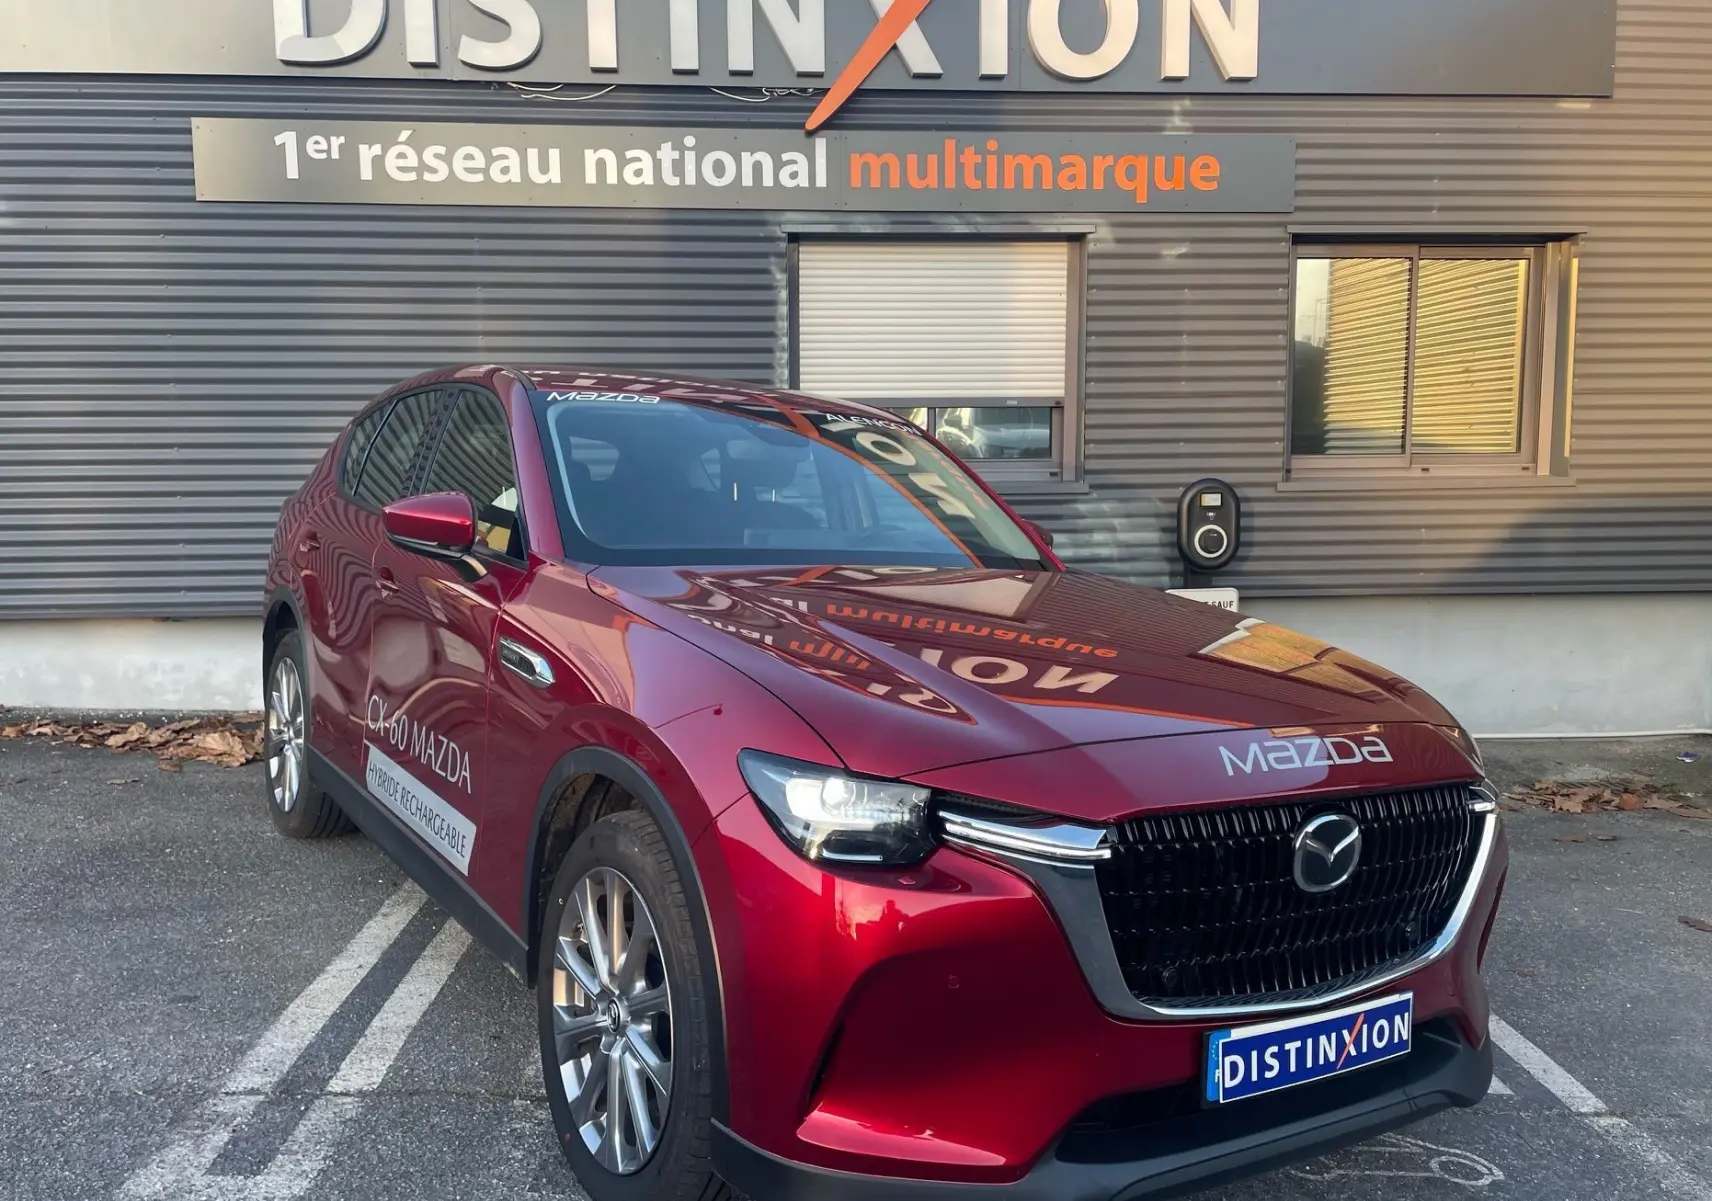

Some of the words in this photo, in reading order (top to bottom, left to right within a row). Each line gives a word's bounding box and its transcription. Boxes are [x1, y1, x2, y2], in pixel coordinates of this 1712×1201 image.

[273, 0, 1258, 132] DISTINXION
[274, 130, 345, 180] 1er
[358, 130, 562, 185] réseau
[584, 135, 827, 188] national
[849, 138, 1221, 204] multimarque
[367, 694, 408, 751] CX-60
[410, 720, 472, 794] MAZDA
[368, 762, 400, 803] HYBRIDE
[400, 786, 467, 858] RECHARGEABLE
[1224, 1011, 1409, 1089] DISTINXION
